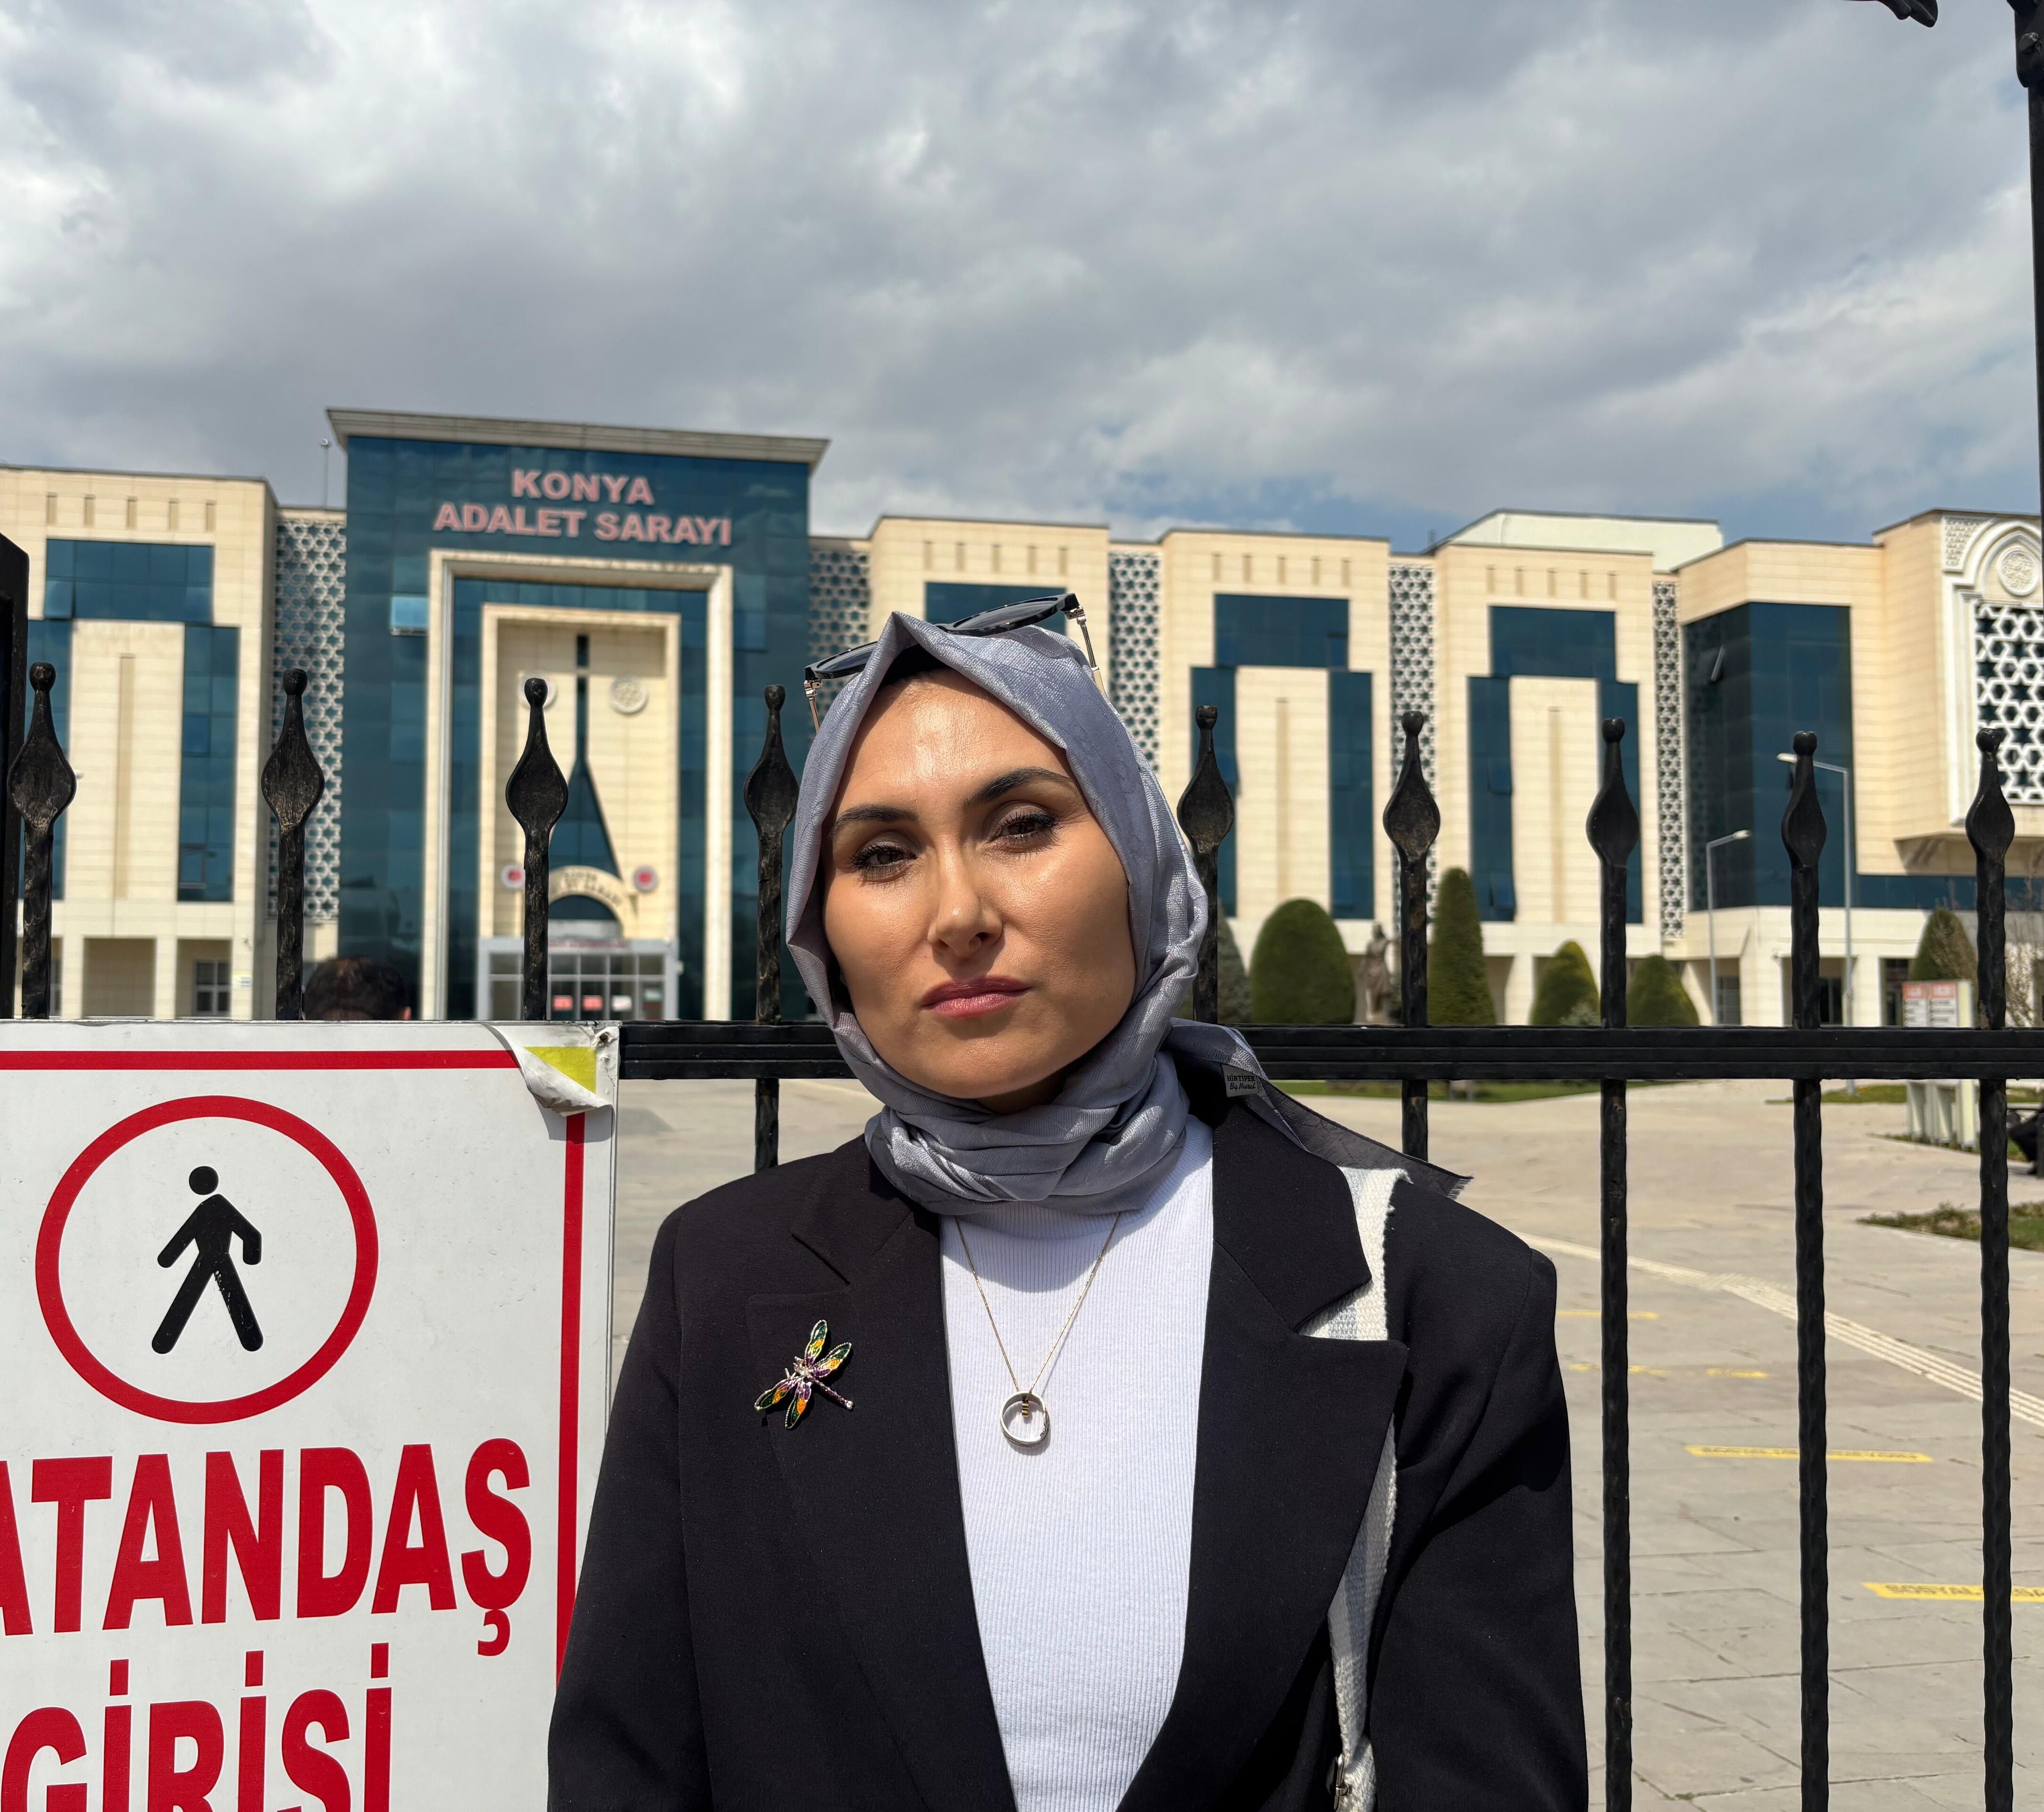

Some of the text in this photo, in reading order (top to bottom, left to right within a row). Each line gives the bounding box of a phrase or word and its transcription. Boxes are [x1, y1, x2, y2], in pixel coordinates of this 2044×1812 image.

[512, 469, 653, 504] KONYA
[433, 503, 731, 545] ADALET SARAYI
